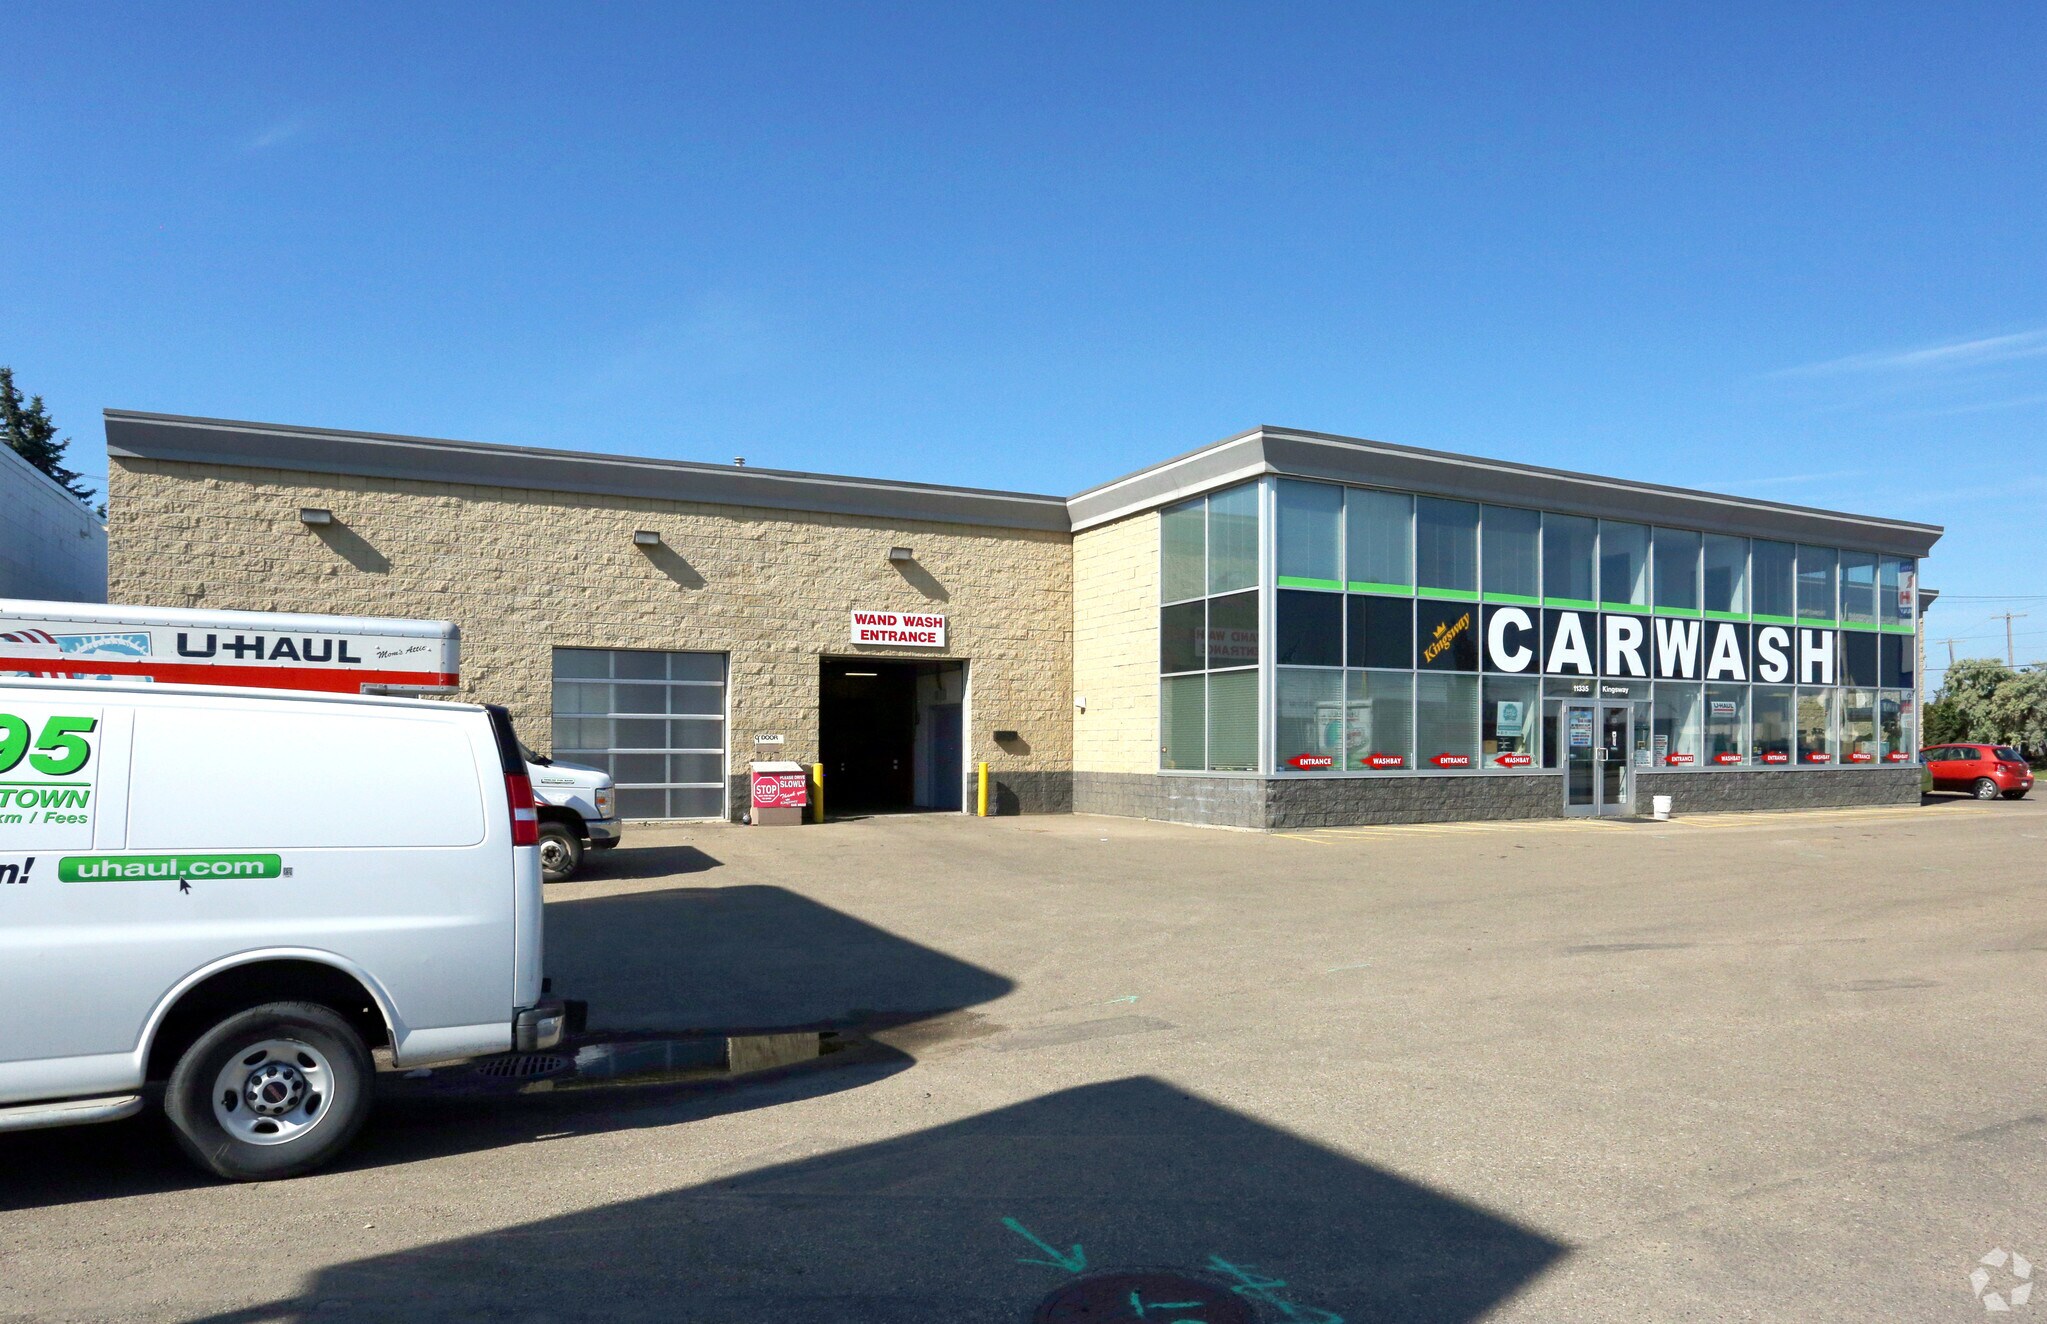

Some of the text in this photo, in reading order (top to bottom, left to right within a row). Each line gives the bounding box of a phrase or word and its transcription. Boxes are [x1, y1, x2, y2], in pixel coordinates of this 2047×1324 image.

[854, 613, 943, 628] WAND WASH
[860, 629, 937, 643] ENTRANCE
[1424, 612, 1470, 663] Kingsway
[176, 632, 362, 664] U-HAUL
[405, 645, 427, 655] Attic
[1488, 606, 1834, 684] CARWASH
[1573, 685, 1629, 695] 11335 Kingsway
[1299, 756, 1332, 766] ENTRANCE
[1372, 757, 1402, 765] WASHBAY
[1440, 756, 1469, 765] ENTRANCE
[1504, 756, 1531, 764] WASHBAY
[779, 780, 806, 788] SLOWLY
[756, 785, 778, 795] STOP
[0, 789, 91, 808] TOWN
[43, 811, 88, 824] Fees
[77, 858, 265, 878] uhaul.com
